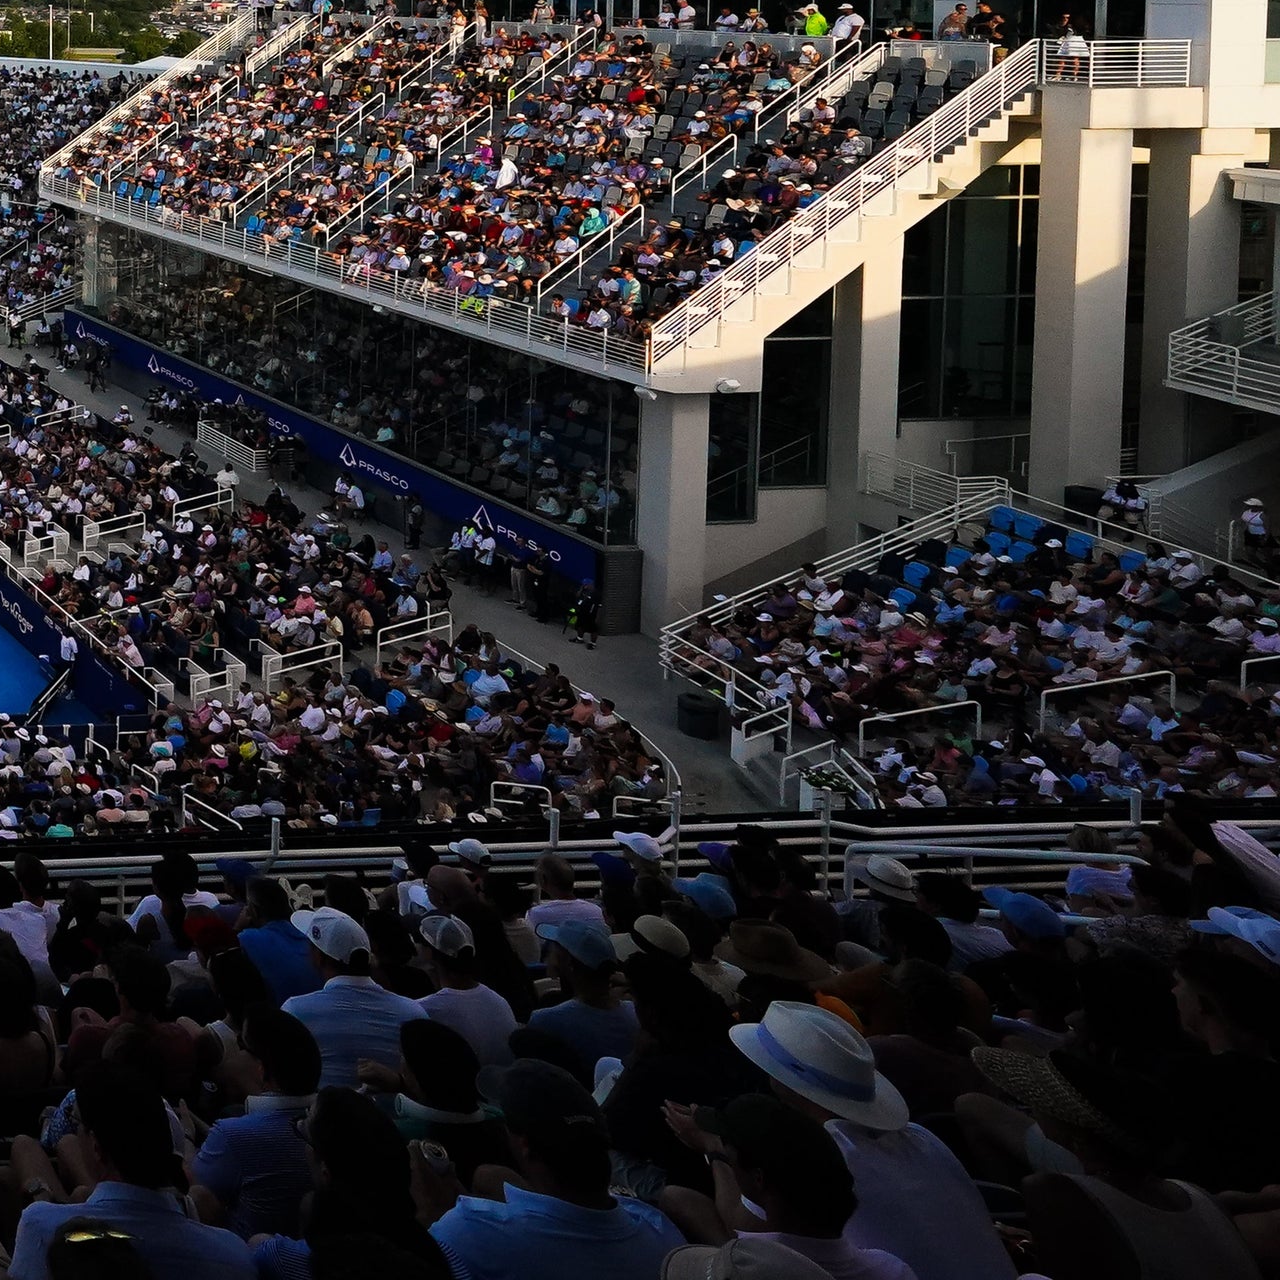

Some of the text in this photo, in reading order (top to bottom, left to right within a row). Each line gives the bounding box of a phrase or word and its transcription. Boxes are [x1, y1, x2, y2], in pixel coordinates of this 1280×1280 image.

[86, 332, 110, 348] PRASC
[160, 366, 194, 388] PRASCO
[358, 460, 409, 490] PRASCO
[497, 524, 562, 562] PRSO
[10, 602, 34, 634] Kroger
